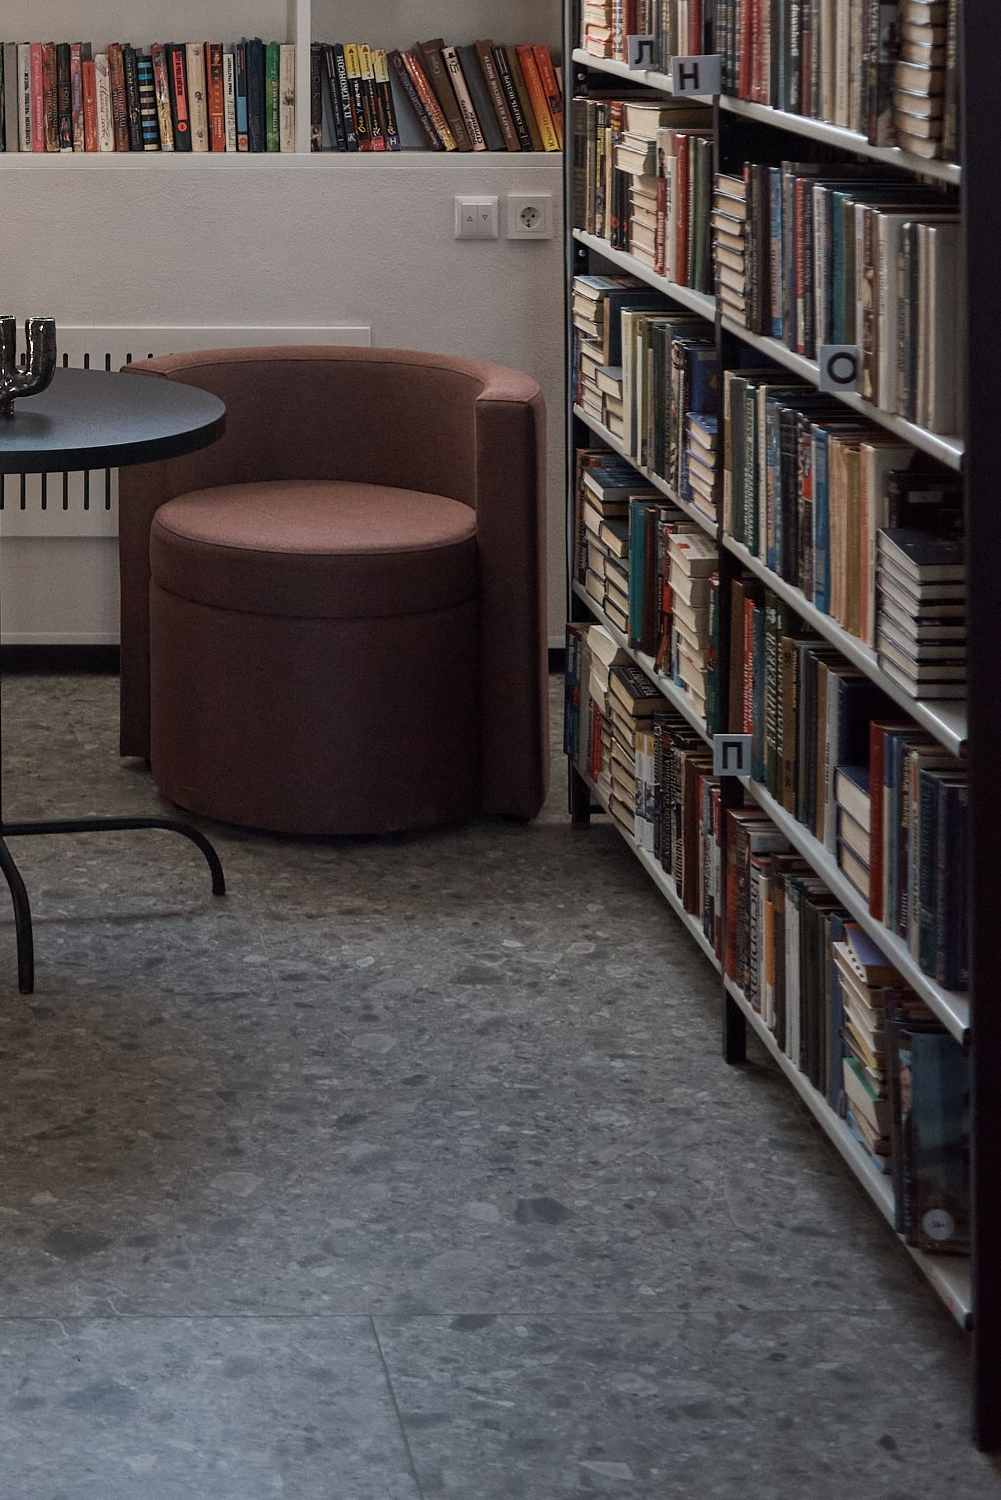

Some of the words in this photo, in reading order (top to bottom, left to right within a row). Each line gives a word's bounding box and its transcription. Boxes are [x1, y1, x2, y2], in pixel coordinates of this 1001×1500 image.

[634, 40, 654, 65] Л
[337, 54, 349, 100] ДЖОНСОН
[679, 62, 699, 91] Н
[827, 351, 858, 385] О
[722, 740, 743, 770] П
